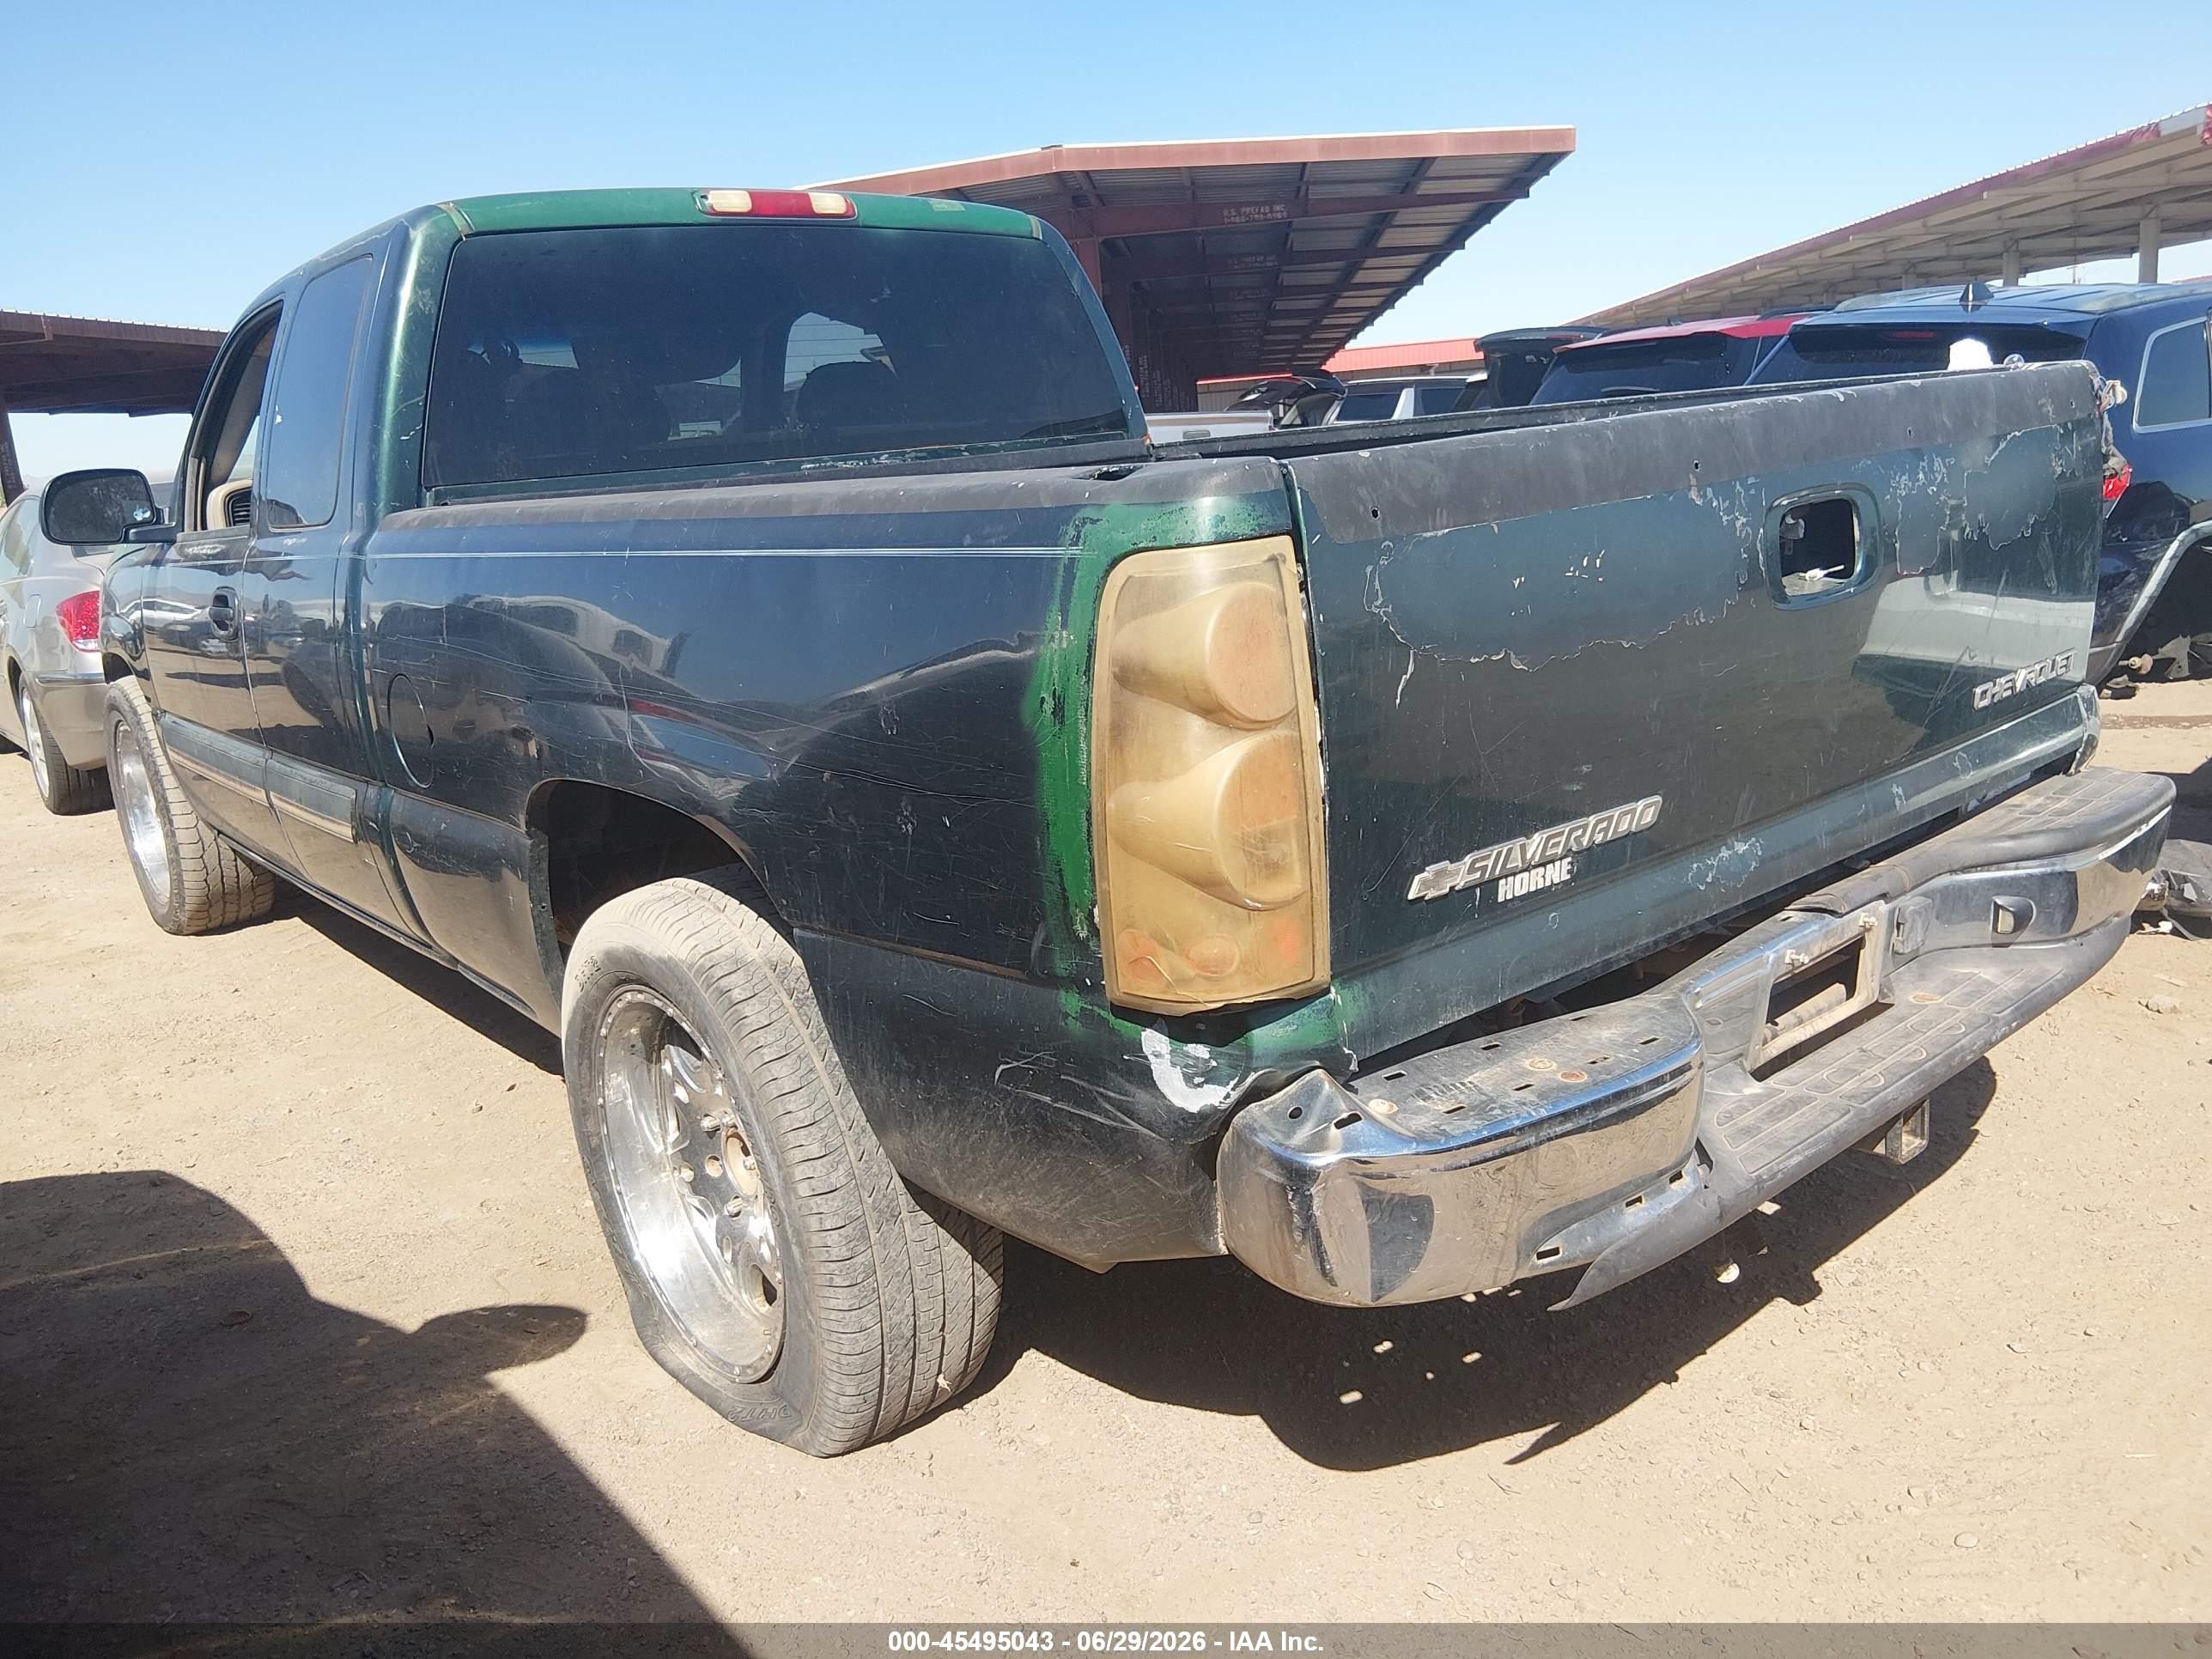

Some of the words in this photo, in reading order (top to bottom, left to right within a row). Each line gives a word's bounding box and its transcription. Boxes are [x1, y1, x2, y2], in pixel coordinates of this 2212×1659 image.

[1972, 649, 2075, 711] CHEVROLET
[1461, 795, 1662, 888] SILVERADO
[1498, 857, 1571, 903] HORNE
